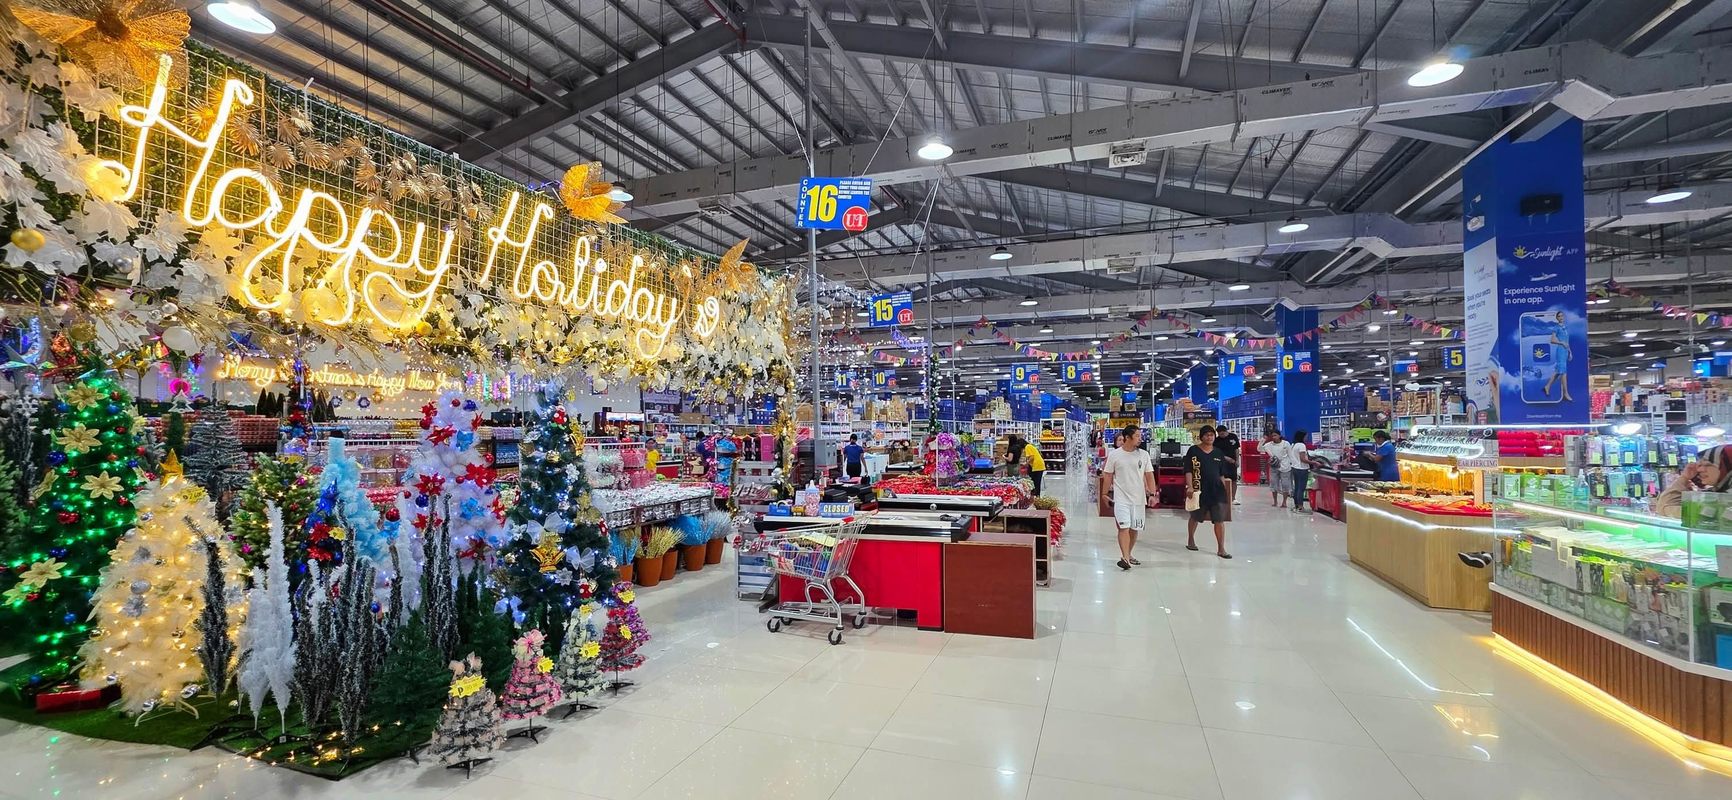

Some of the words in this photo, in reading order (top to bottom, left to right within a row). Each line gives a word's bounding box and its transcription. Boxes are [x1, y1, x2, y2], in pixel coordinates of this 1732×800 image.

[85, 54, 455, 328] Happy
[798, 179, 808, 227] COUNTER
[807, 184, 838, 222] 16
[1530, 246, 1564, 262] Sunlight
[1504, 286, 1544, 296] Experience
[1544, 284, 1576, 294] Sunlight
[1504, 296, 1512, 304] in
[1526, 296, 1544, 304] app.
[873, 298, 894, 322] 15
[1282, 354, 1294, 370] 6
[1450, 350, 1463, 366] 5
[218, 355, 276, 387] Merry
[1016, 367, 1024, 380] 9
[1067, 365, 1076, 379] 8
[1228, 359, 1236, 374] 7
[837, 373, 846, 386] 11
[875, 372, 885, 385] 10
[1470, 459, 1498, 467] PIERCING
[824, 504, 850, 513] CLOSED
